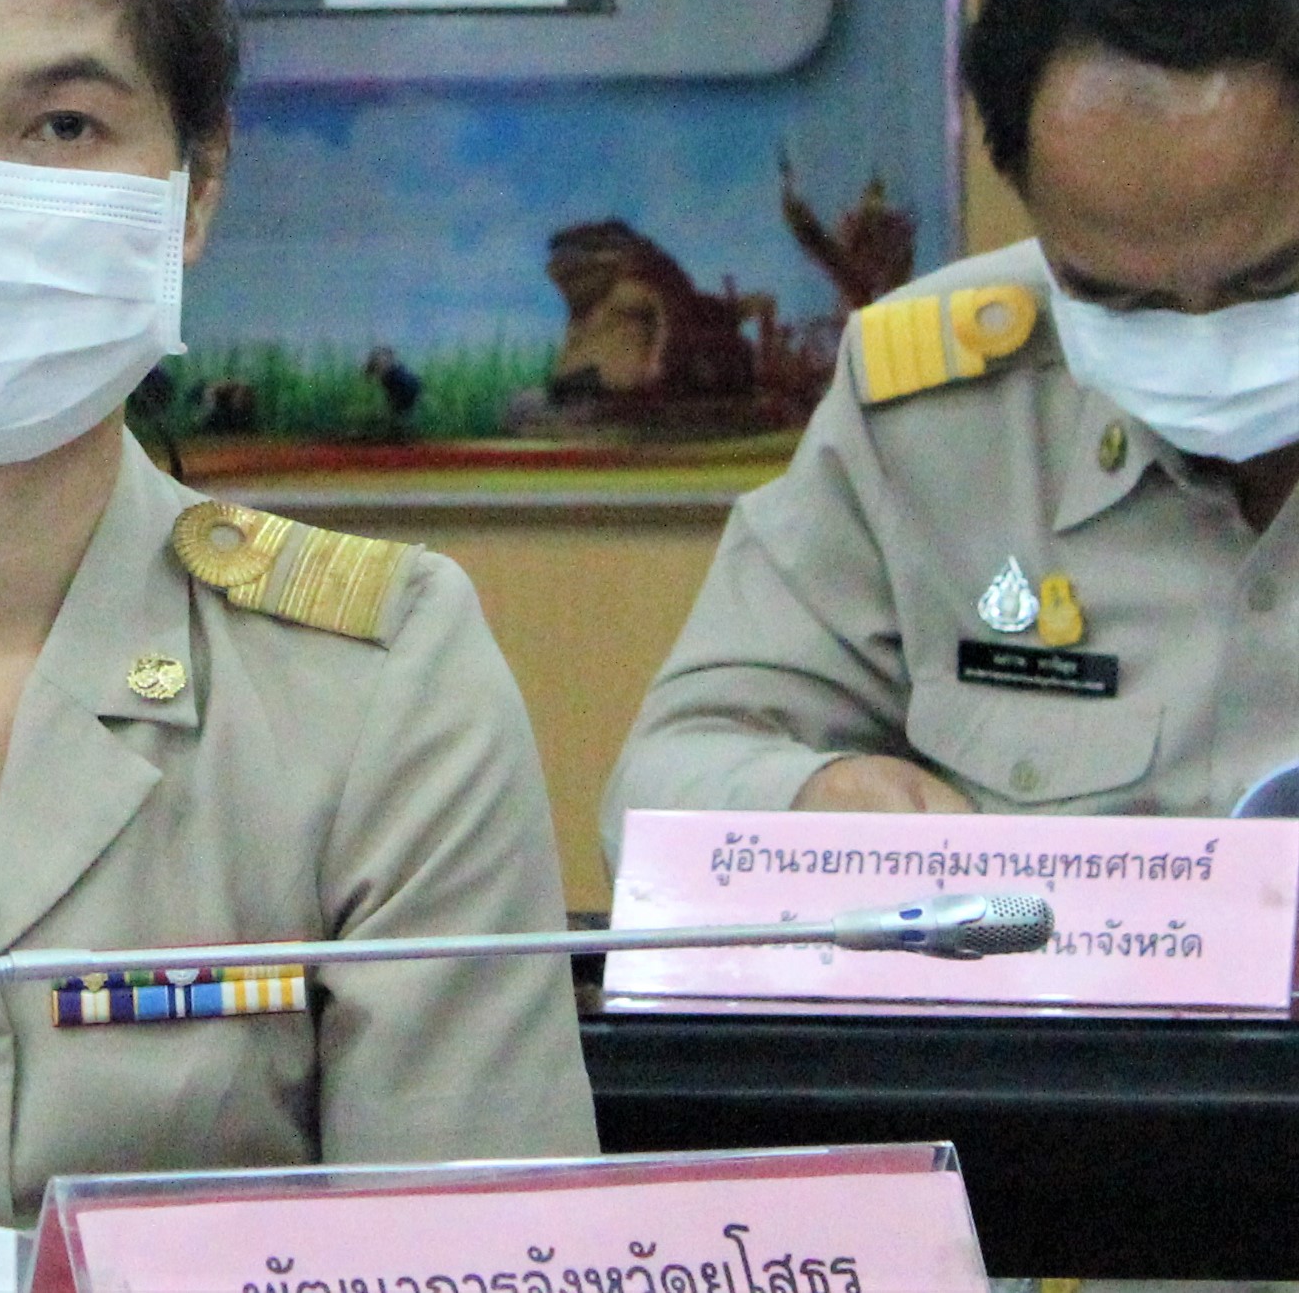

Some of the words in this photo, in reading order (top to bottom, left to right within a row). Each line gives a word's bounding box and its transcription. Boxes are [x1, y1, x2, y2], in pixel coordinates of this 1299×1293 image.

[711, 832, 1219, 892] ผู้อำนวยการกลุ่มงานยุทธศาสตร์
[242, 1225, 861, 1293] ัจังหวัดยโสธร
